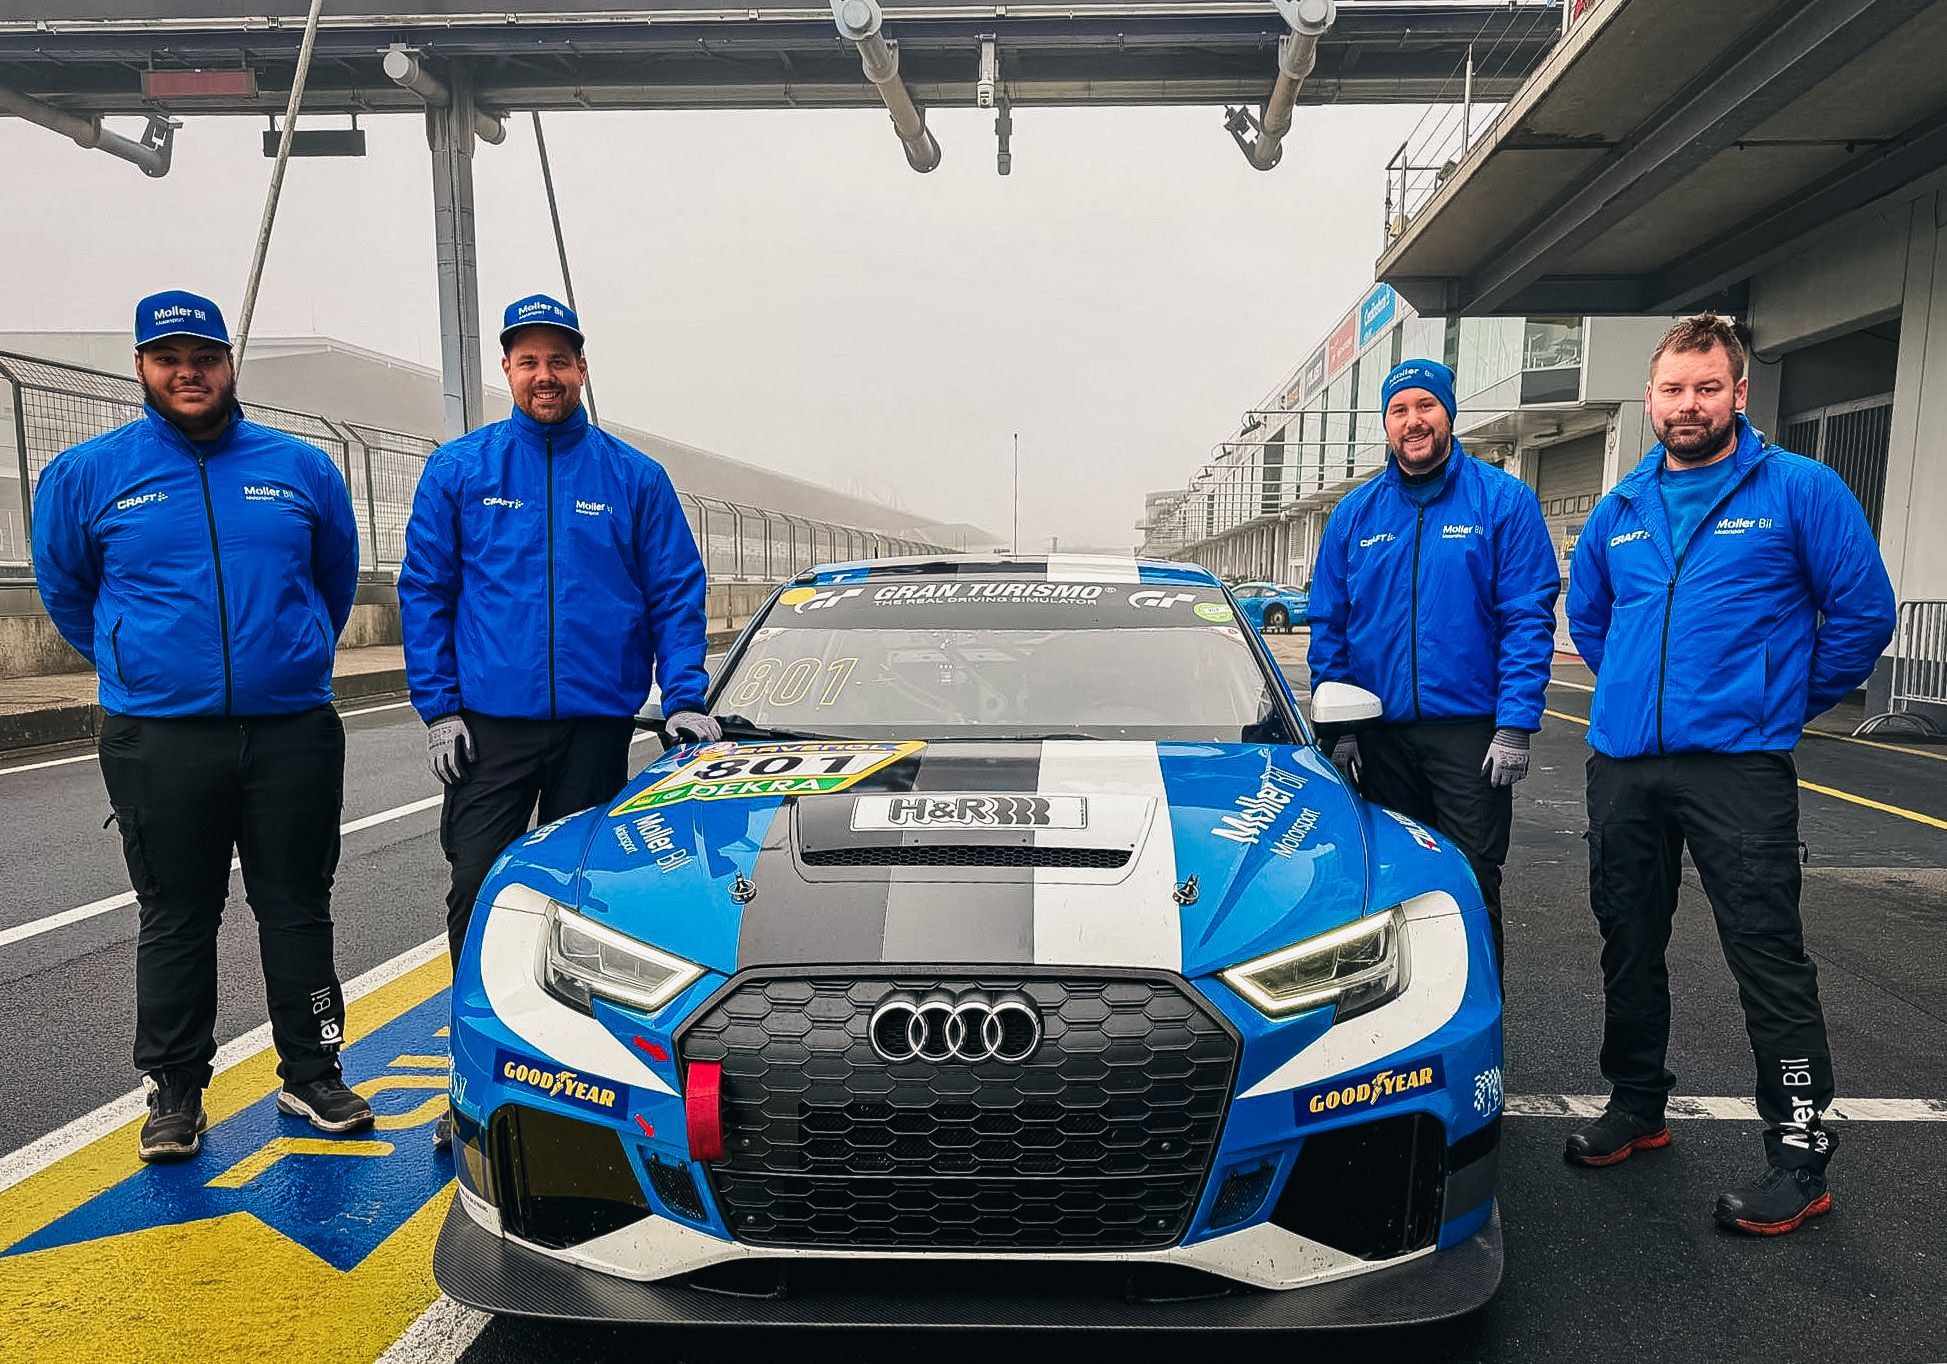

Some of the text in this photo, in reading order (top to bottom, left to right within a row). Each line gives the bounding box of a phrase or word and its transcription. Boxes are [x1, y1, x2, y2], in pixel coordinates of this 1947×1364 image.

[117, 493, 157, 510] CRAFT
[282, 489, 294, 499] Bil
[1758, 518, 1773, 529] Bil
[1610, 531, 1644, 547] CRAFT
[873, 583, 962, 601] GRAN
[873, 600, 903, 608] THE
[947, 596, 1007, 604] DRIVING
[1011, 597, 1097, 605] SIMULATOR
[729, 657, 859, 707] 801
[693, 754, 856, 780] 801
[687, 778, 821, 798] DEKRA
[888, 797, 994, 826] H&R
[612, 823, 639, 855] Motorsport
[1269, 807, 1321, 859] Motorsport
[656, 848, 694, 874] Bil
[310, 986, 331, 1014] Bil
[503, 1061, 616, 1108] GOODYEAR
[1780, 1058, 1811, 1086] Bil
[1309, 1067, 1433, 1113] GOODYEAR
